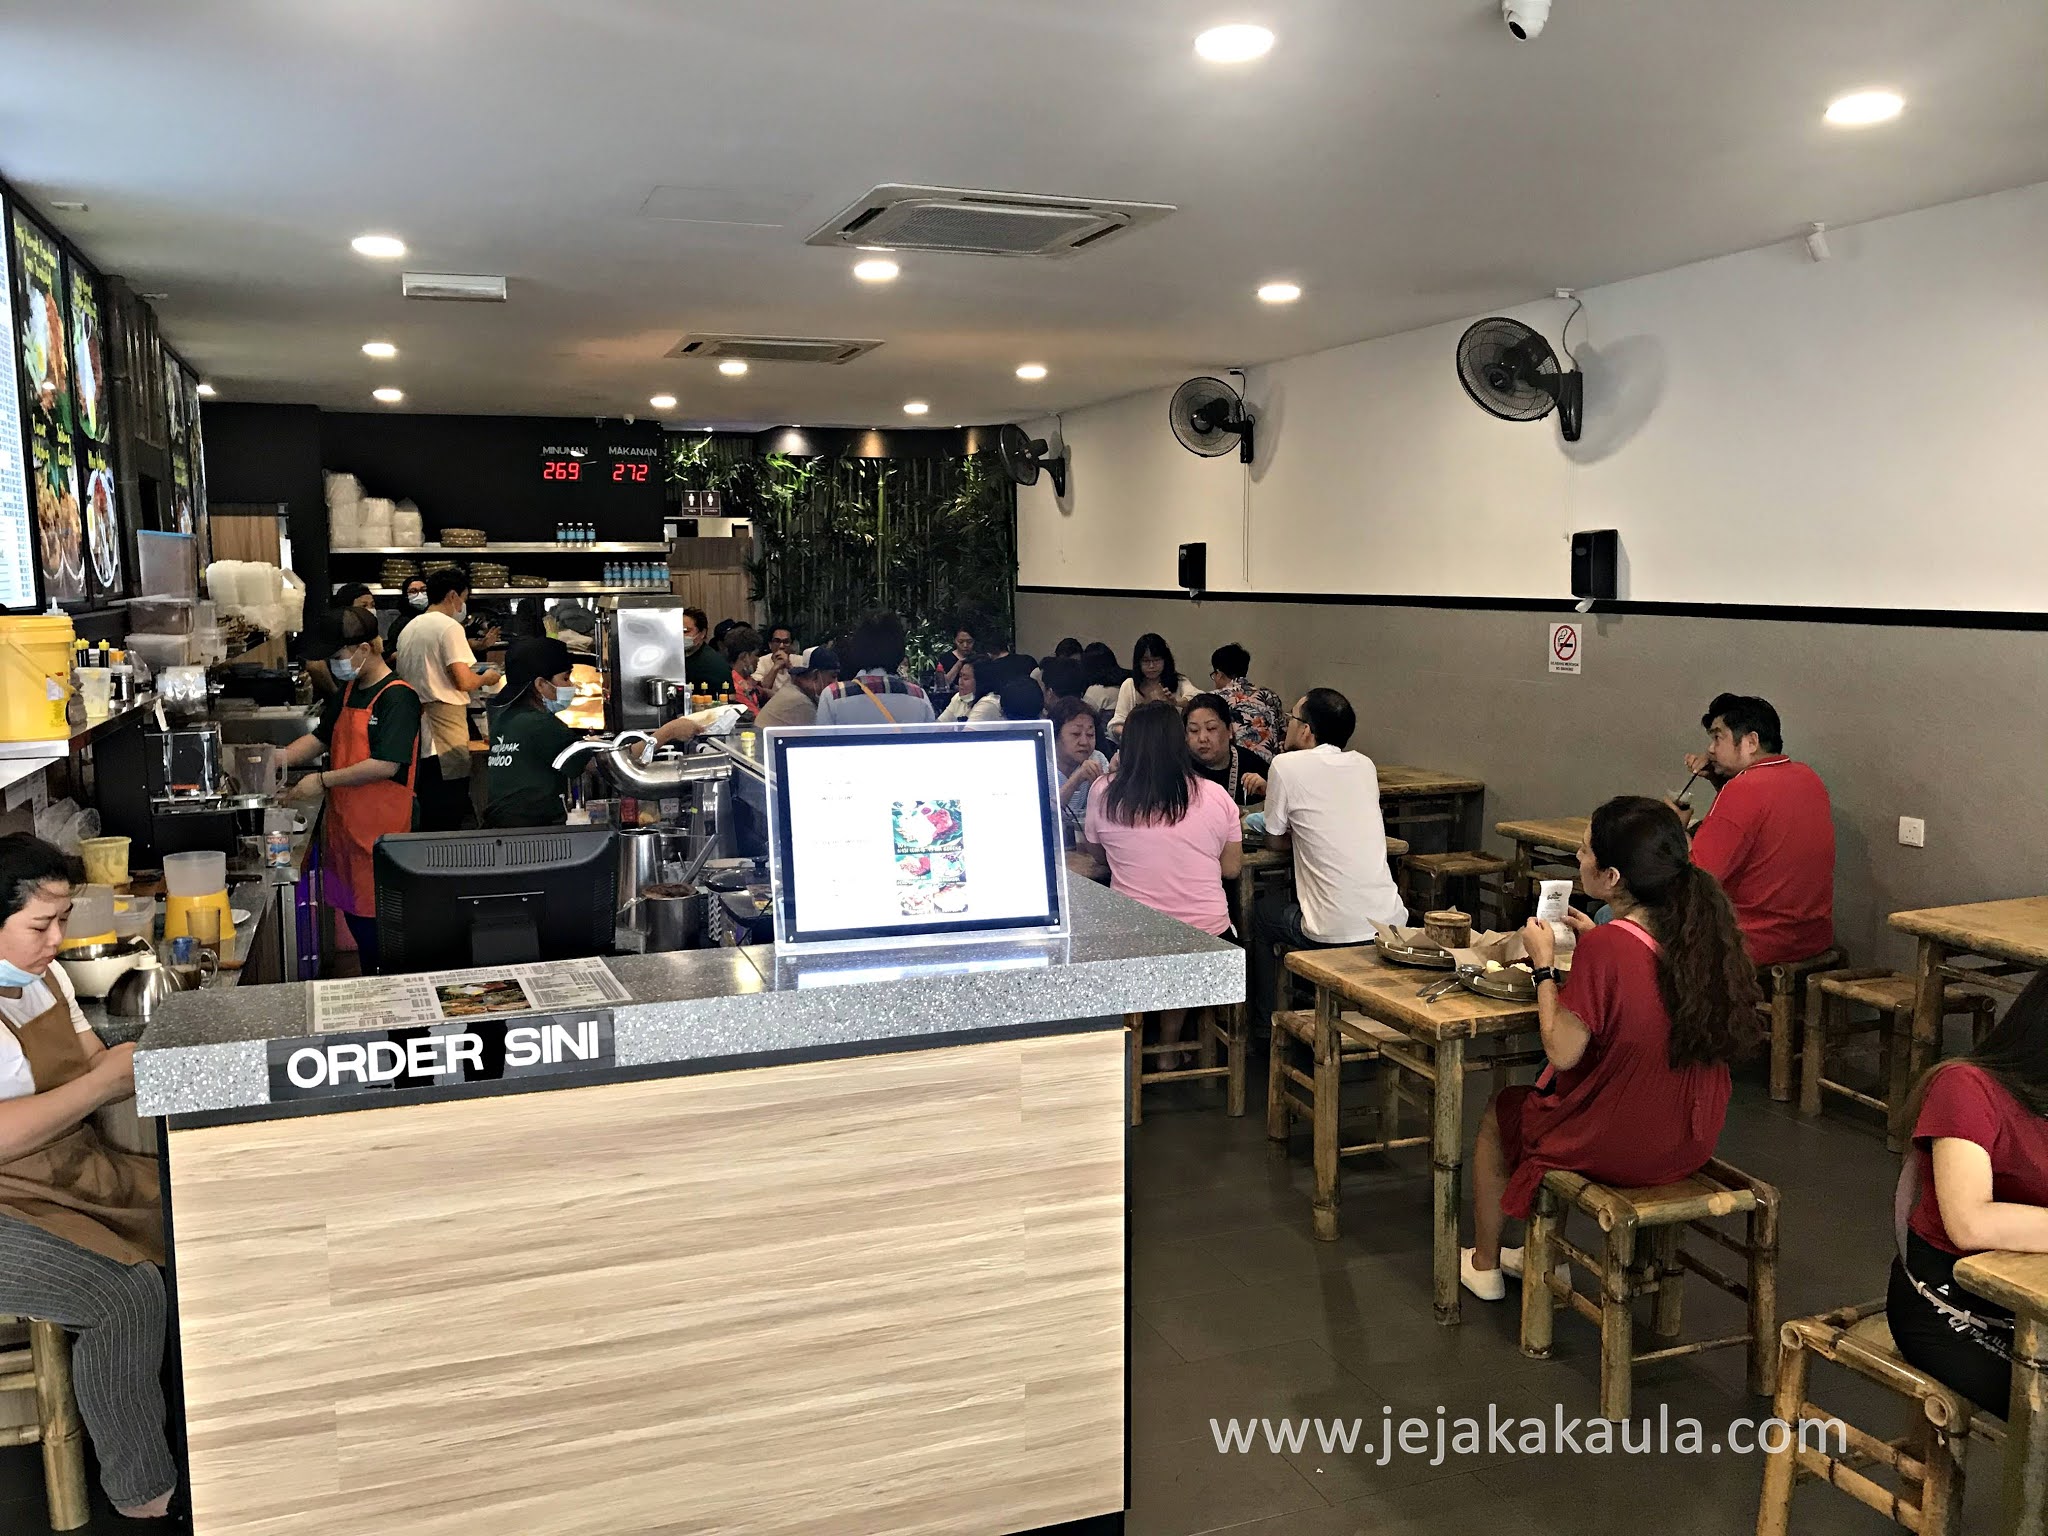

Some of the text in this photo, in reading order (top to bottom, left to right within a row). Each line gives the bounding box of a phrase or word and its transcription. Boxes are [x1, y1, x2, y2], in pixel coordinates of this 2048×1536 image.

[543, 446, 588, 455] MINUMAN
[609, 446, 657, 457] MAKANAN
[544, 462, 580, 480] 269
[613, 464, 648, 481] 272
[286, 1020, 600, 1089] ORDER SINI
